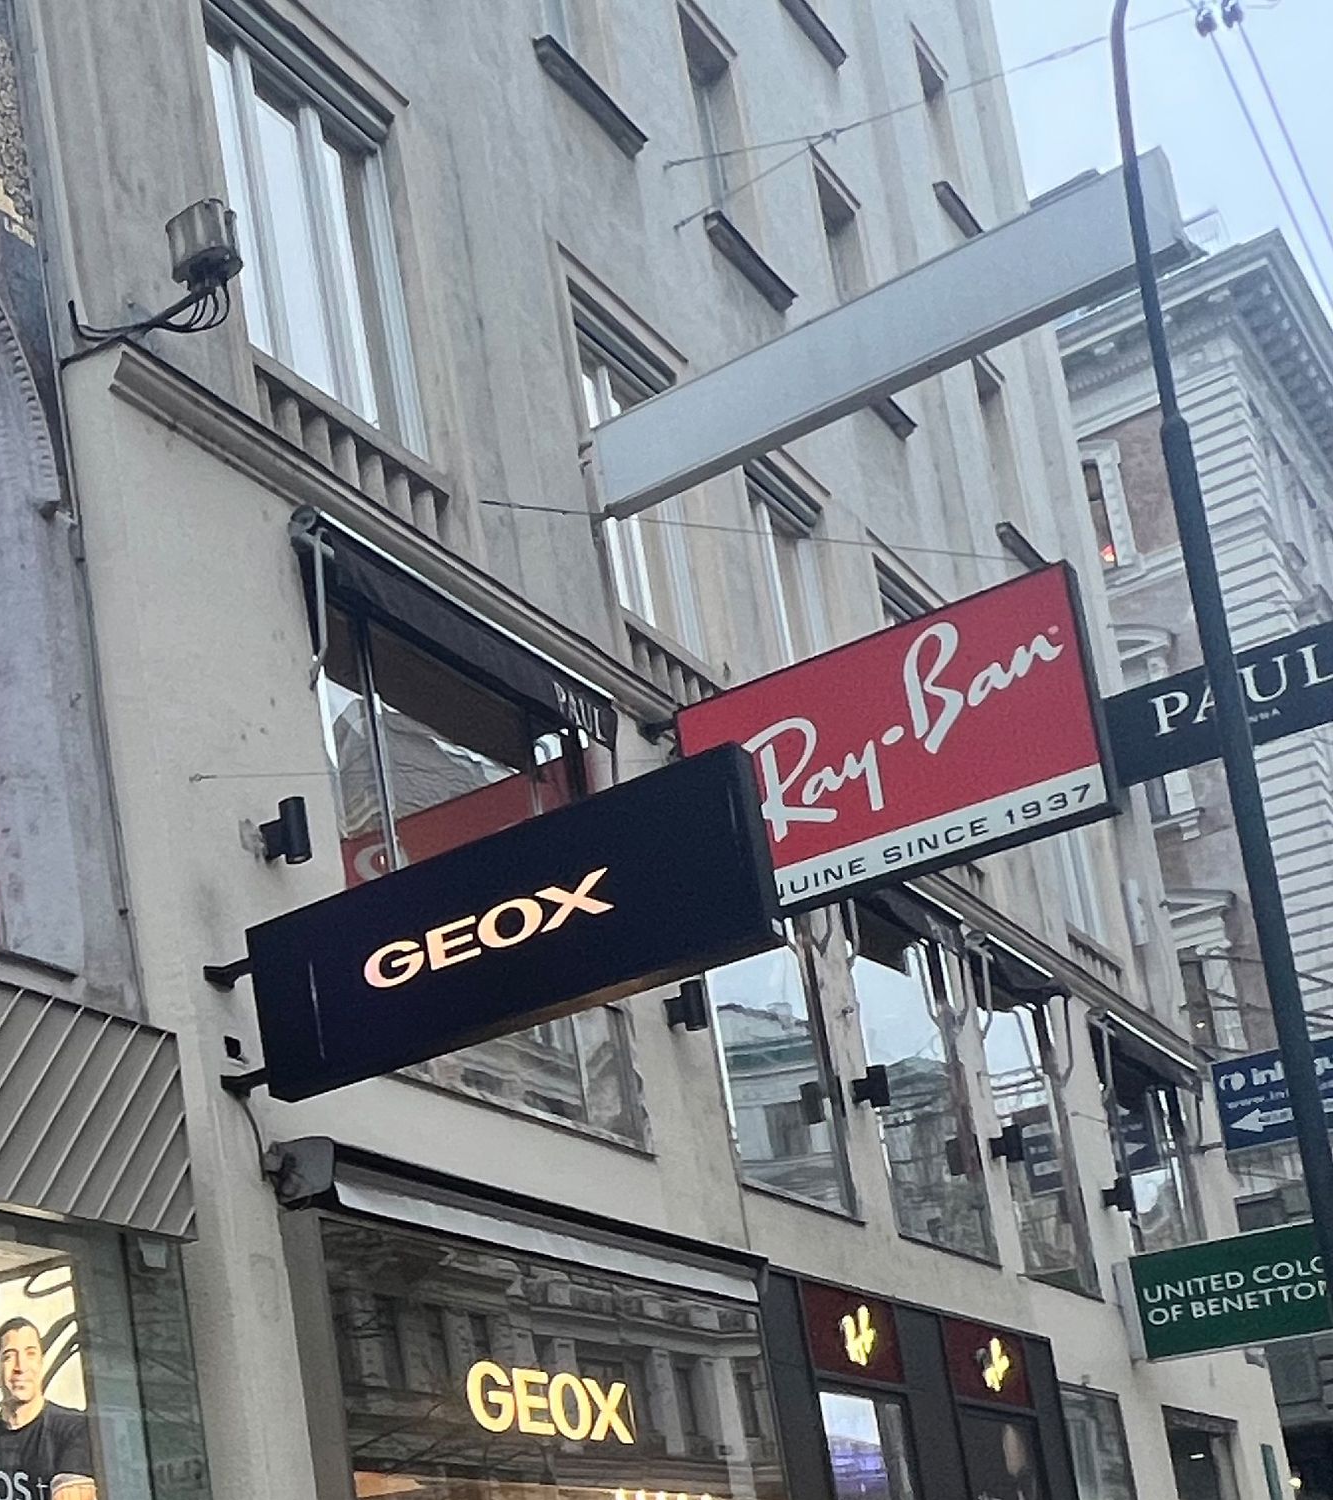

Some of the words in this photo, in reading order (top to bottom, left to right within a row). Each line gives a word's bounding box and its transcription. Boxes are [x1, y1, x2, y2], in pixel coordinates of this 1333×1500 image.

[553, 681, 608, 742] PAUL
[741, 621, 1065, 843] Ray-Ban
[779, 857, 867, 899] UINE
[883, 817, 989, 865] SINCE
[1005, 783, 1091, 826] 1937
[363, 866, 616, 989] GEOX
[1142, 1270, 1245, 1304] UNITED
[1251, 1255, 1325, 1285] COLO
[1147, 1304, 1184, 1326] OF
[466, 1359, 636, 1445] GEOX
